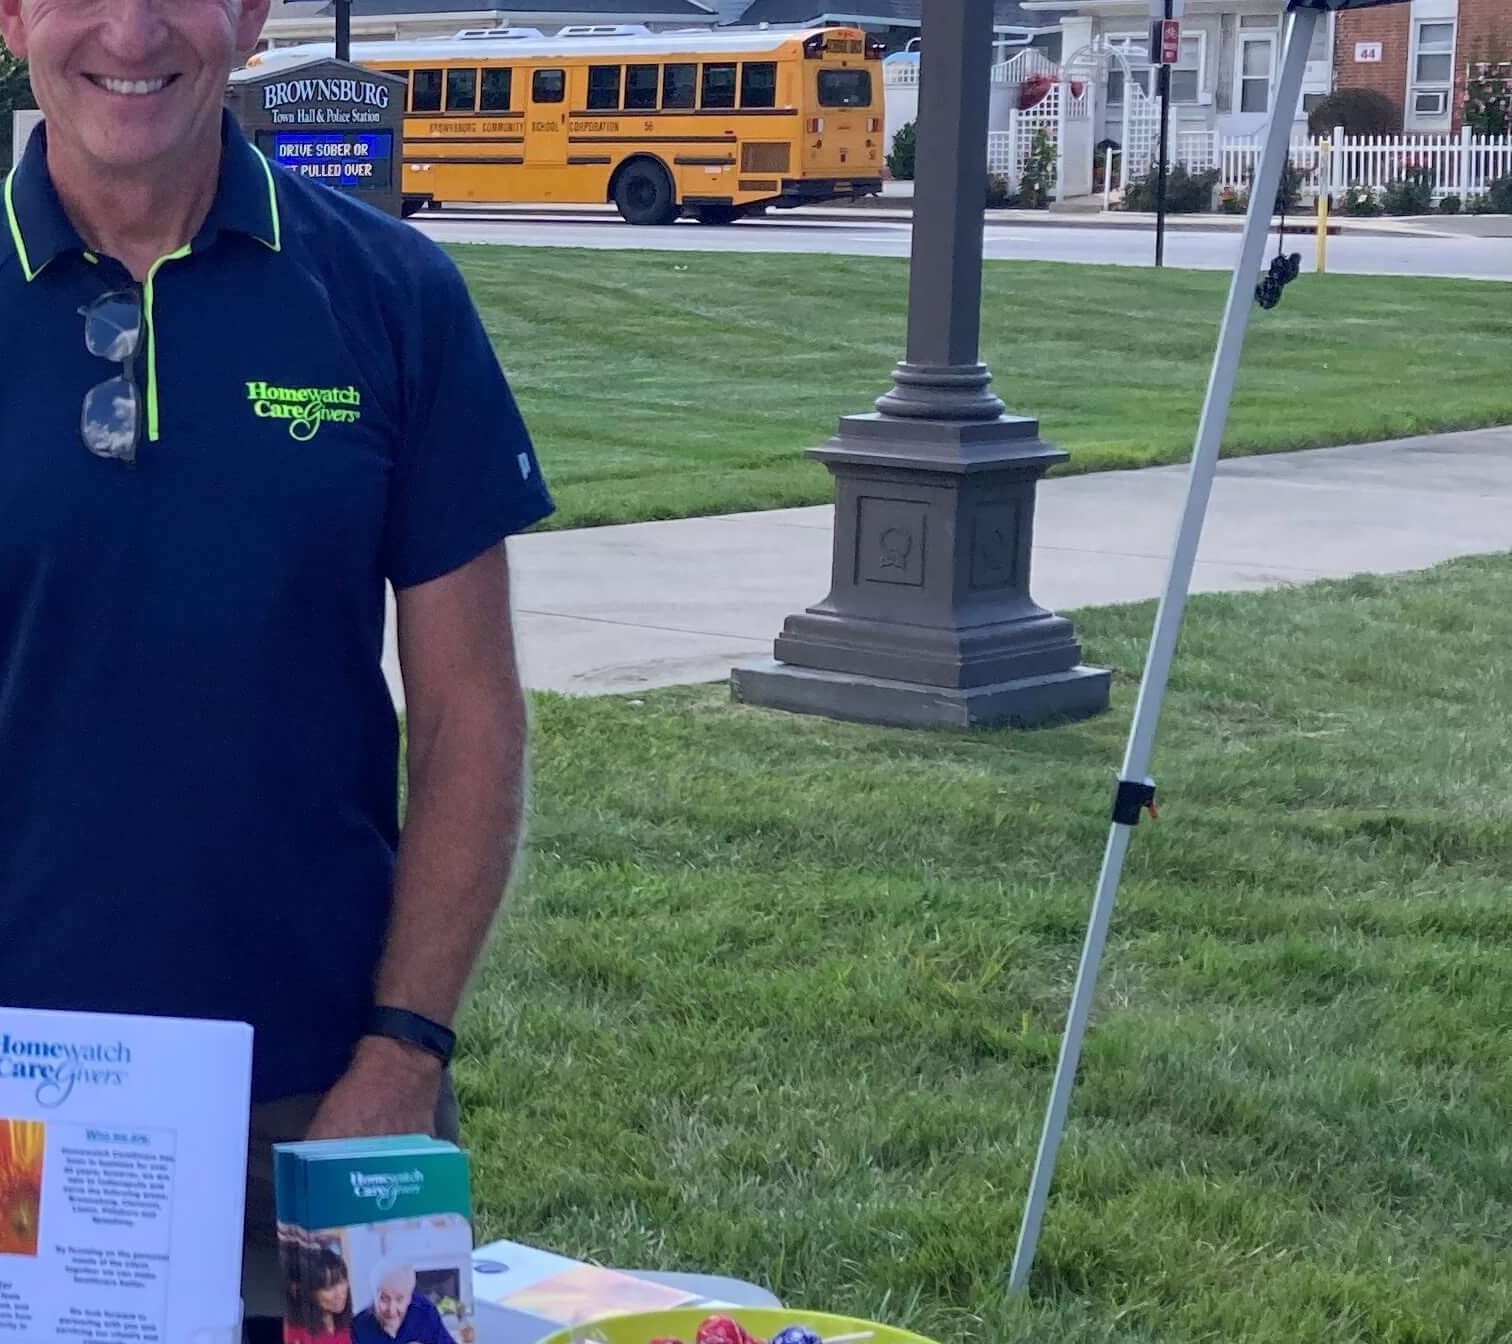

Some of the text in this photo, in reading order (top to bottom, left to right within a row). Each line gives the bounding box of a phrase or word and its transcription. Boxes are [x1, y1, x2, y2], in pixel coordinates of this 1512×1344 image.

[1360, 47, 1375, 59] 44
[263, 78, 389, 109] BROWNSBURG
[271, 107, 380, 123] Town Hall & Police Station
[279, 144, 369, 157] DRIVE SOBER OR
[300, 163, 341, 177] PULLED
[344, 163, 373, 176] OVER
[245, 381, 361, 405] Homewatch
